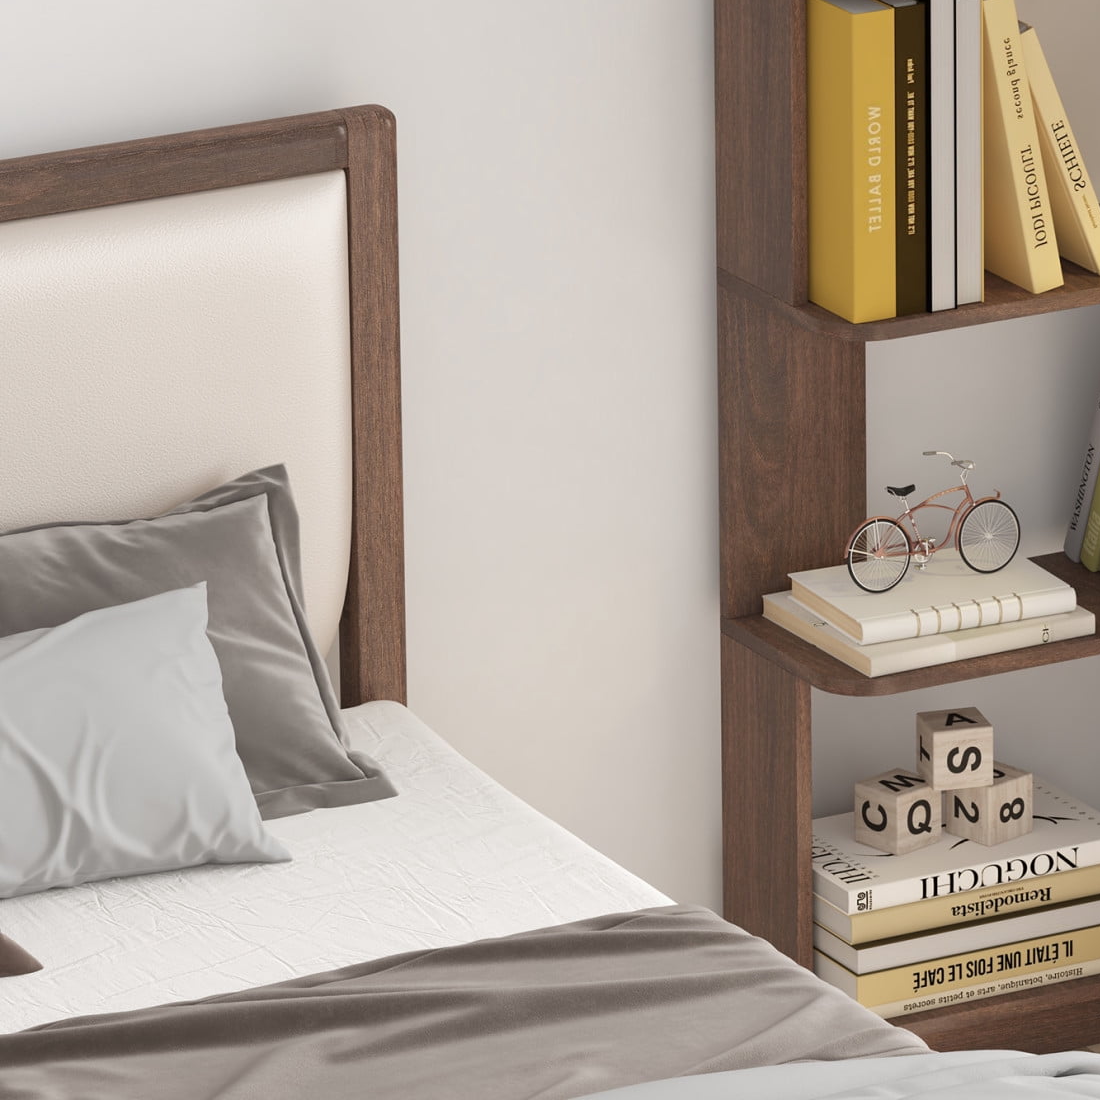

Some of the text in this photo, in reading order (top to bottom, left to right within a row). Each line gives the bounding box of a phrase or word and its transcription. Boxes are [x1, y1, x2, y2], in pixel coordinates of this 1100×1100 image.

[1070, 444, 1095, 530] WASHINGTON
[945, 712, 977, 726] A
[946, 746, 982, 774] S
[862, 801, 887, 832] C
[907, 799, 932, 835] Q
[954, 795, 980, 823] 2
[1000, 797, 1024, 823] 8
[921, 847, 1079, 899] NOGUCHI
[951, 886, 1052, 918] Remodelista
[913, 940, 1073, 993] IL ÉTAIT UNE FOIS LE CAFÉ
[938, 992, 963, 1004] petits
[977, 986, 995, 996] arts
[903, 1000, 936, 1011] secrets
